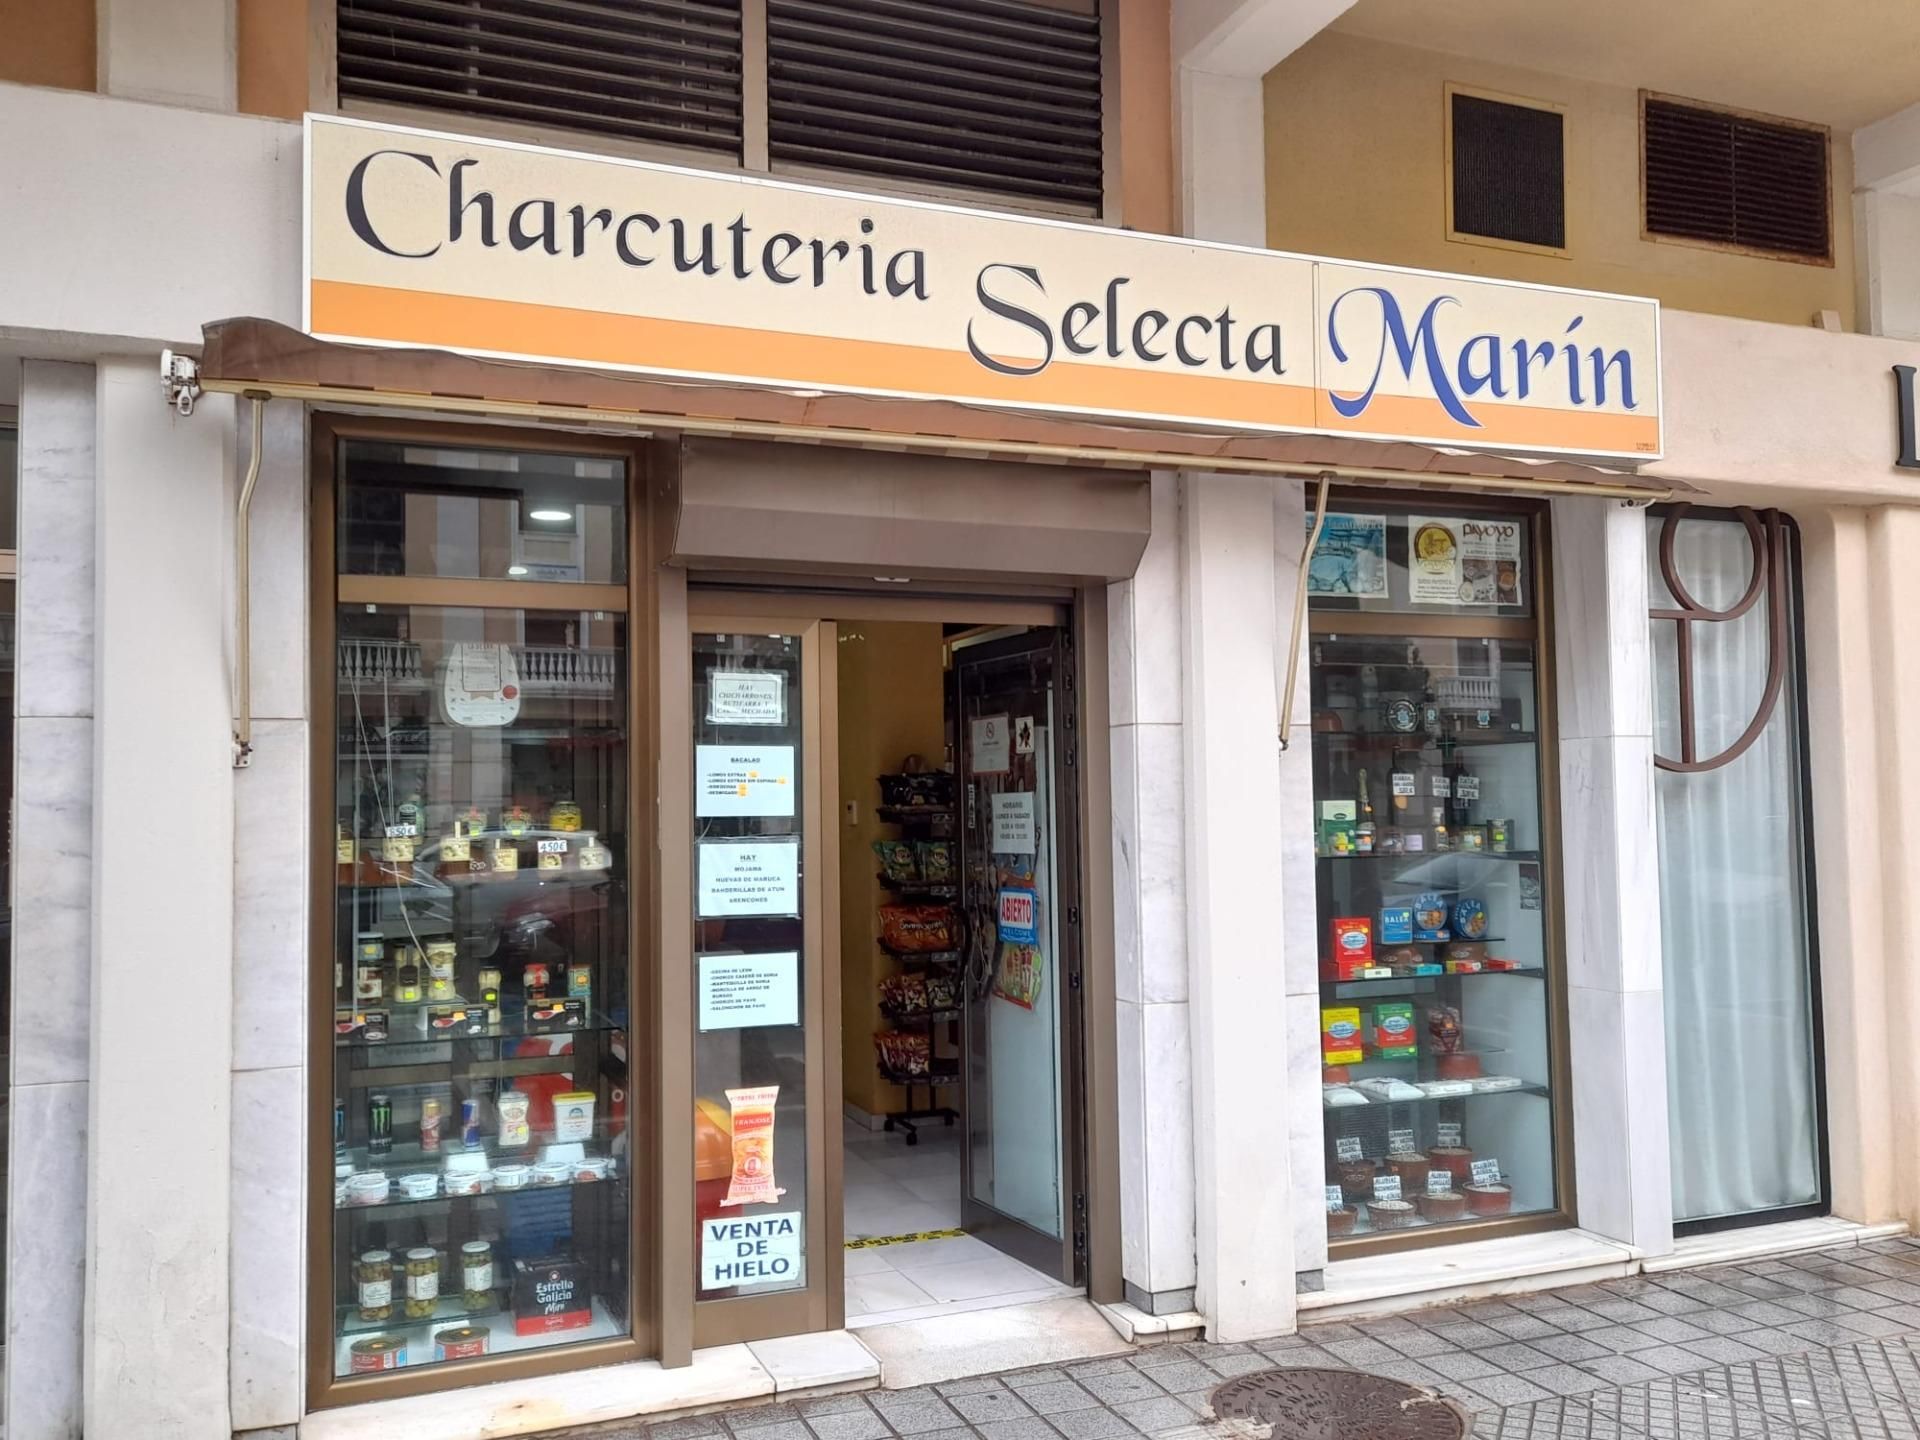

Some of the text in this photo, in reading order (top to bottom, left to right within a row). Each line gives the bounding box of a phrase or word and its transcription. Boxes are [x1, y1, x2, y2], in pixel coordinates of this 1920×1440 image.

[346, 149, 1638, 428] Charcuteria Selecta Marín
[1463, 523, 1514, 542] PAYOYO
[1001, 896, 1032, 924] ABIERTO
[1002, 928, 1032, 937] WELCOME
[711, 1219, 794, 1241] VENTA
[737, 1240, 768, 1258] DE
[715, 1258, 789, 1281] HIELO
[536, 1280, 574, 1293] Estrella
[536, 1291, 573, 1304] Galicia
